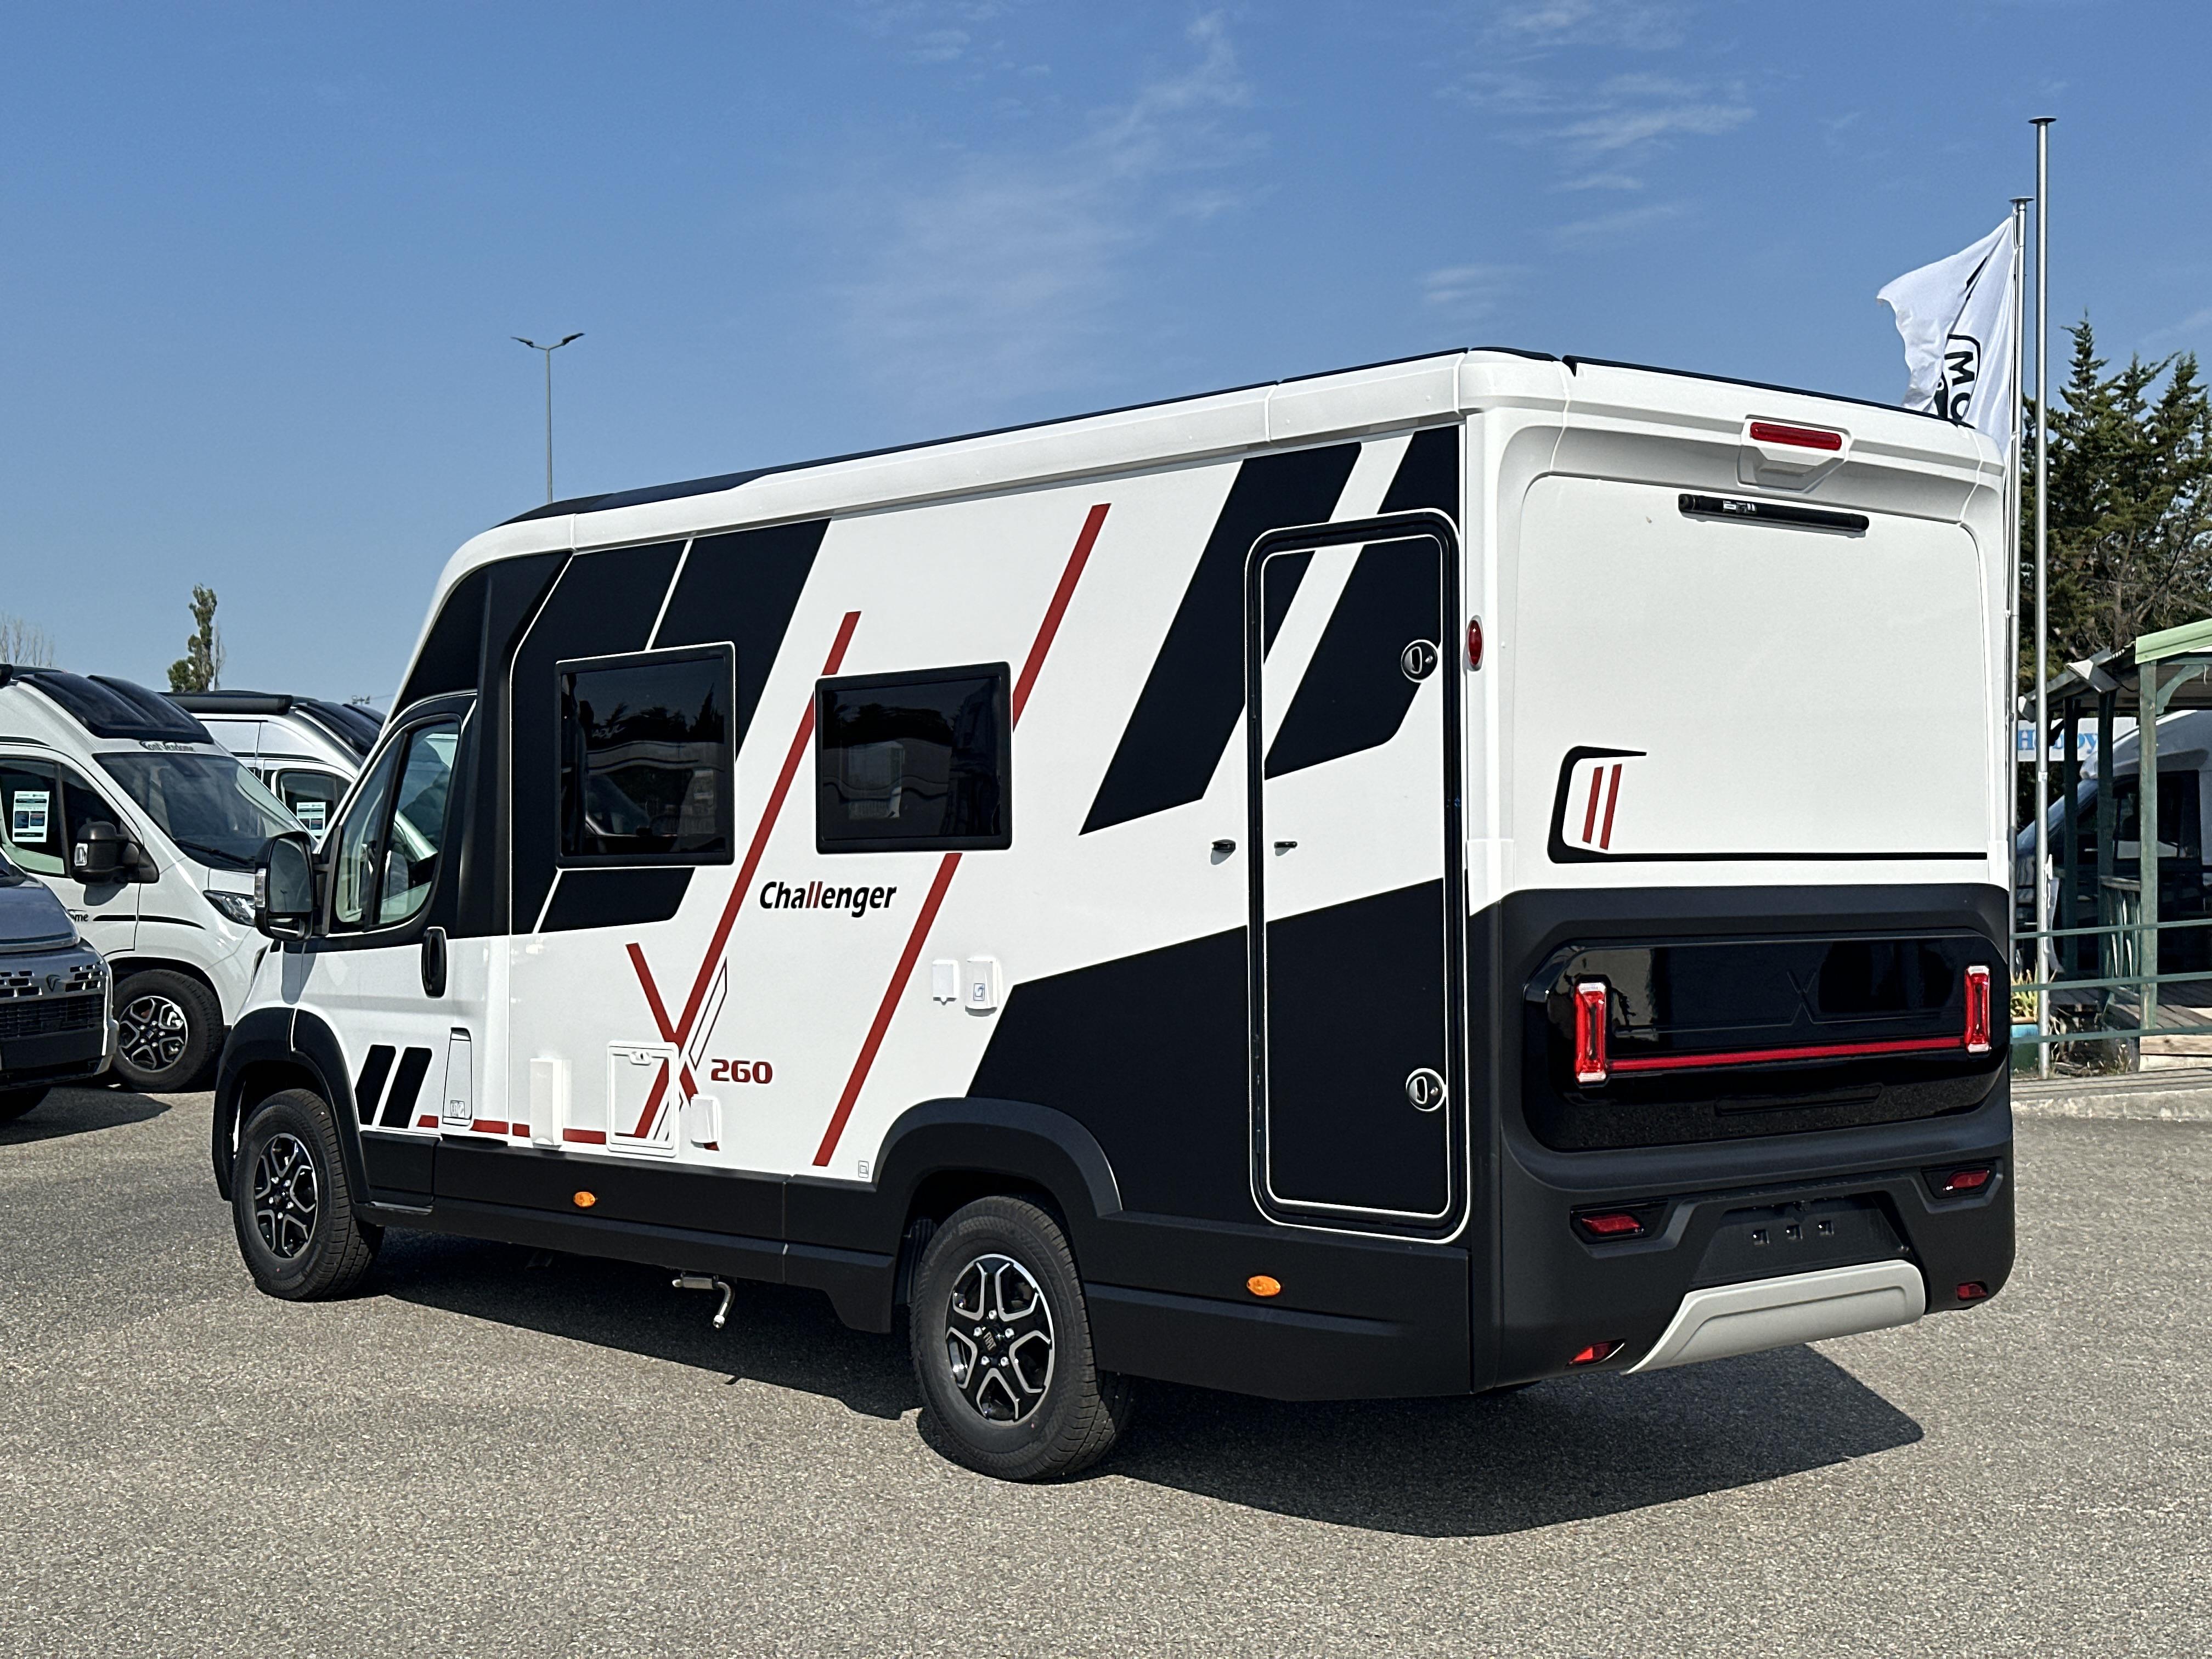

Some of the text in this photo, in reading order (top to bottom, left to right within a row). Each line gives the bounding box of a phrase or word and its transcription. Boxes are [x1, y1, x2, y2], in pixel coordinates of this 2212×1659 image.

[760, 881, 897, 918] Challenger
[711, 1058, 772, 1084] 260
[983, 1331, 996, 1351] FIAT
